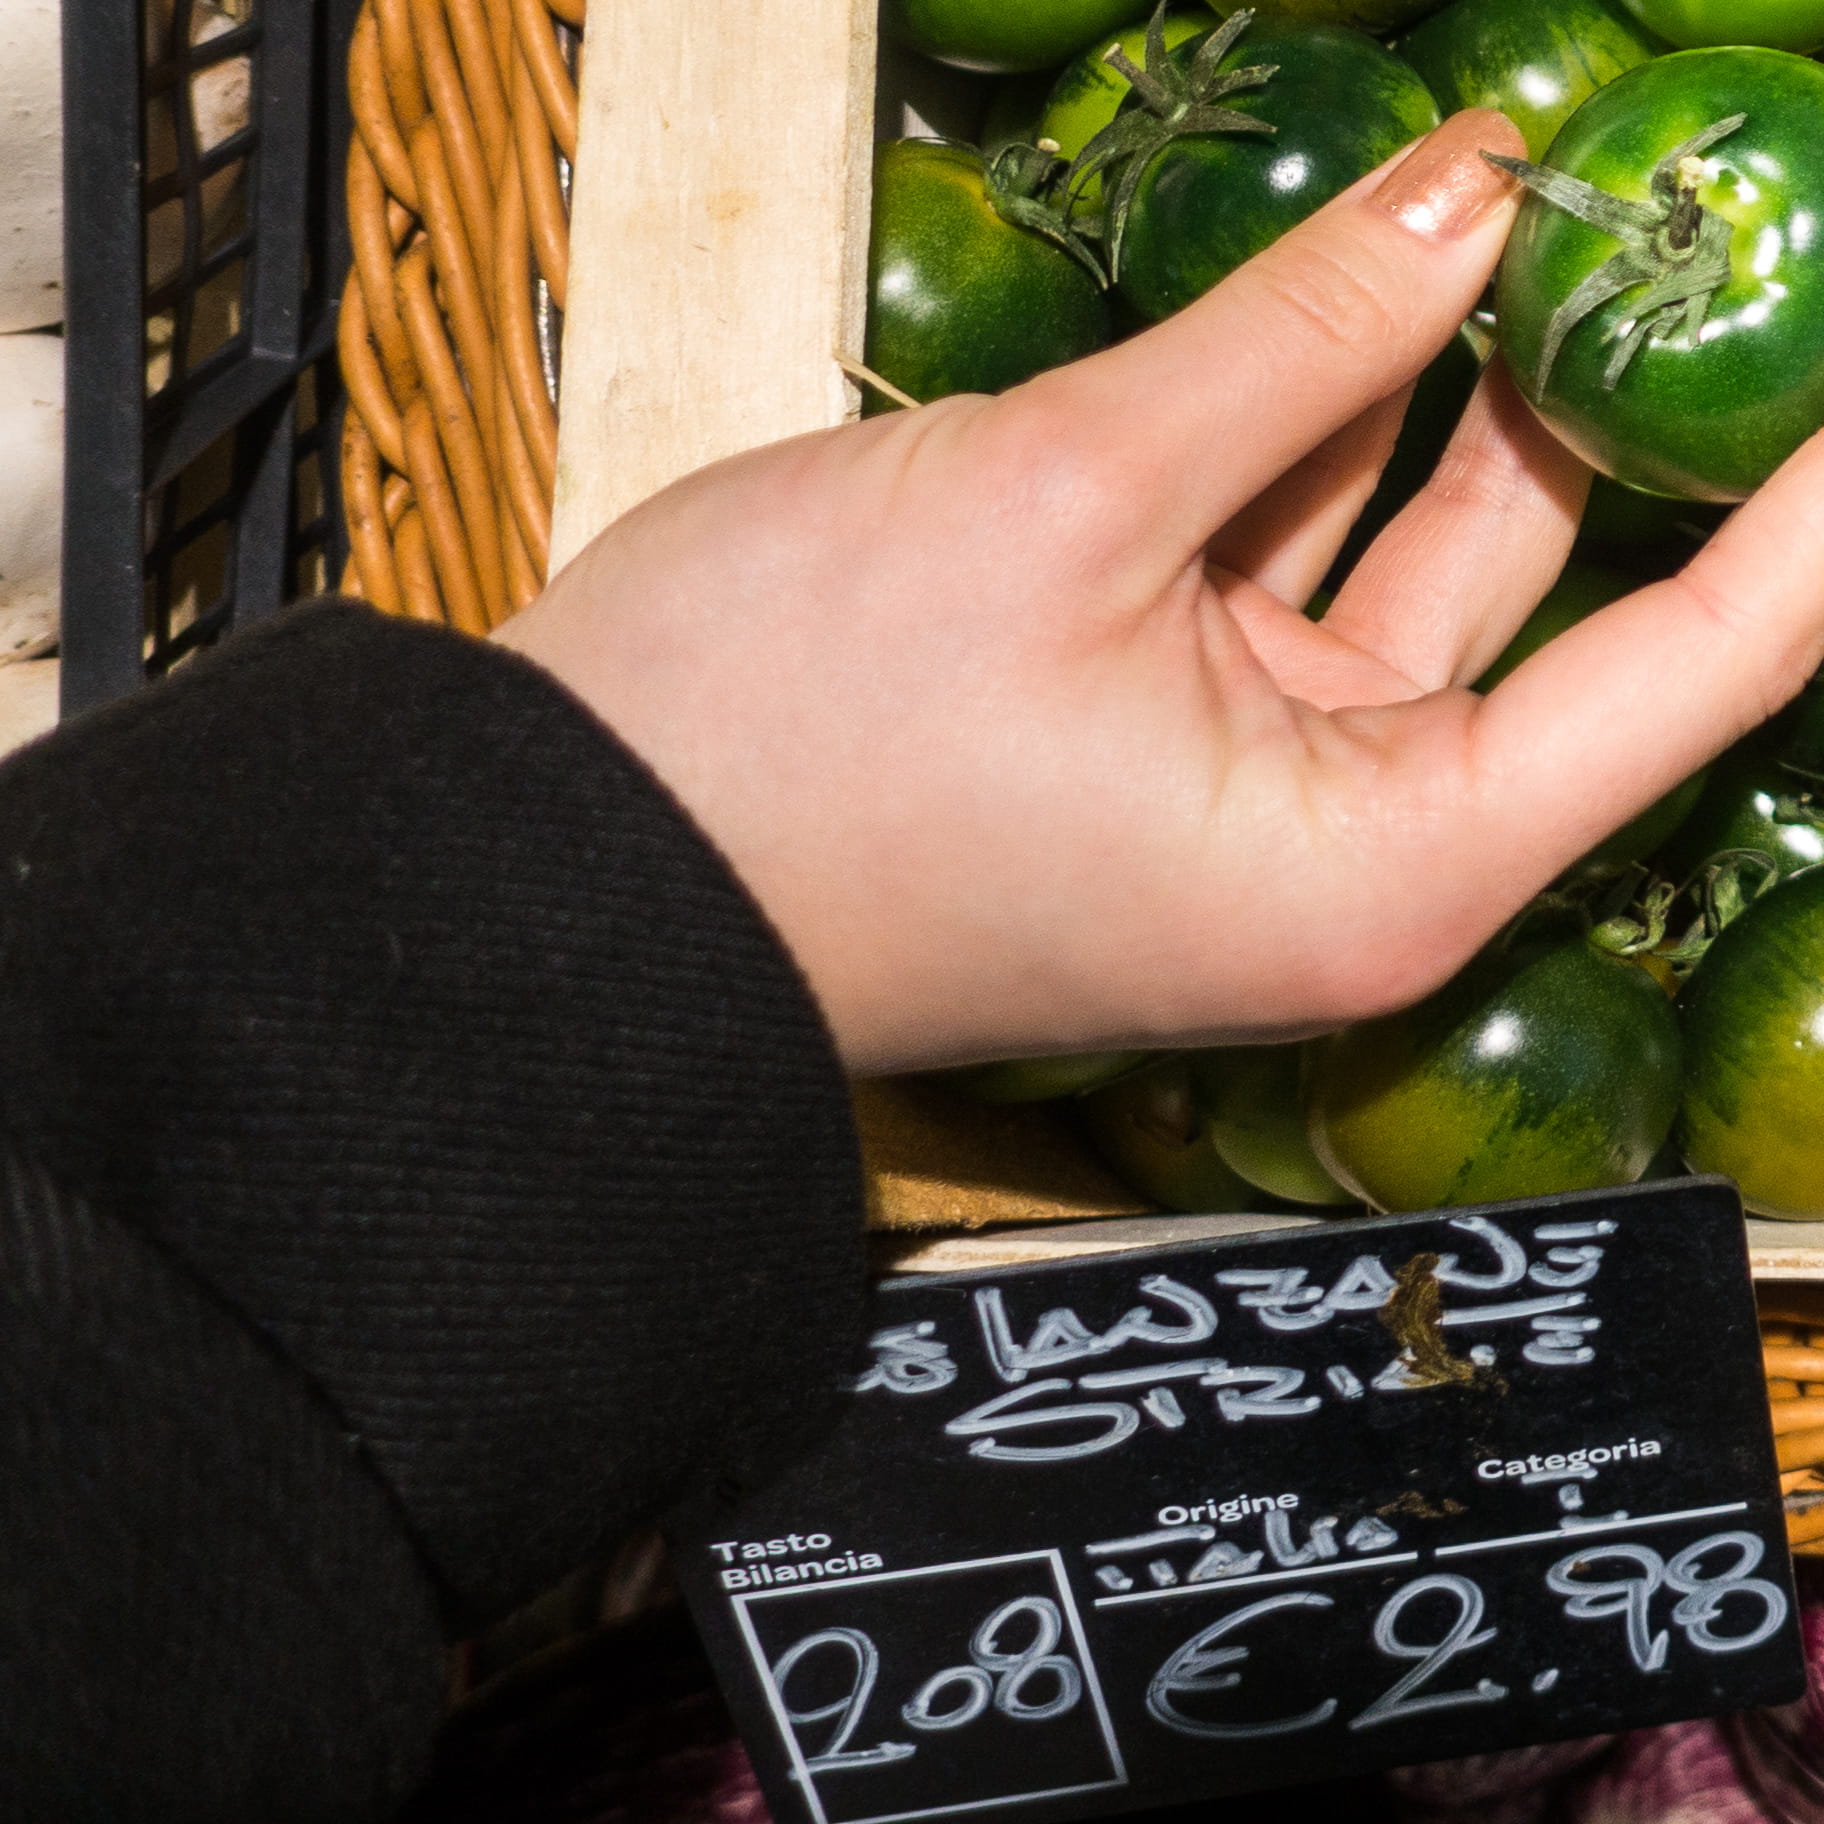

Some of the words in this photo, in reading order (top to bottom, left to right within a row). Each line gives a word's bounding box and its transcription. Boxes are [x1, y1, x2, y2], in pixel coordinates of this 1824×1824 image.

[1477, 1437, 1662, 1480] Categoria
[1157, 1490, 1299, 1526] Origine
[710, 1531, 832, 1564] Tasto
[720, 1550, 884, 1590] Bilancia
[771, 1596, 1082, 1781] 208
